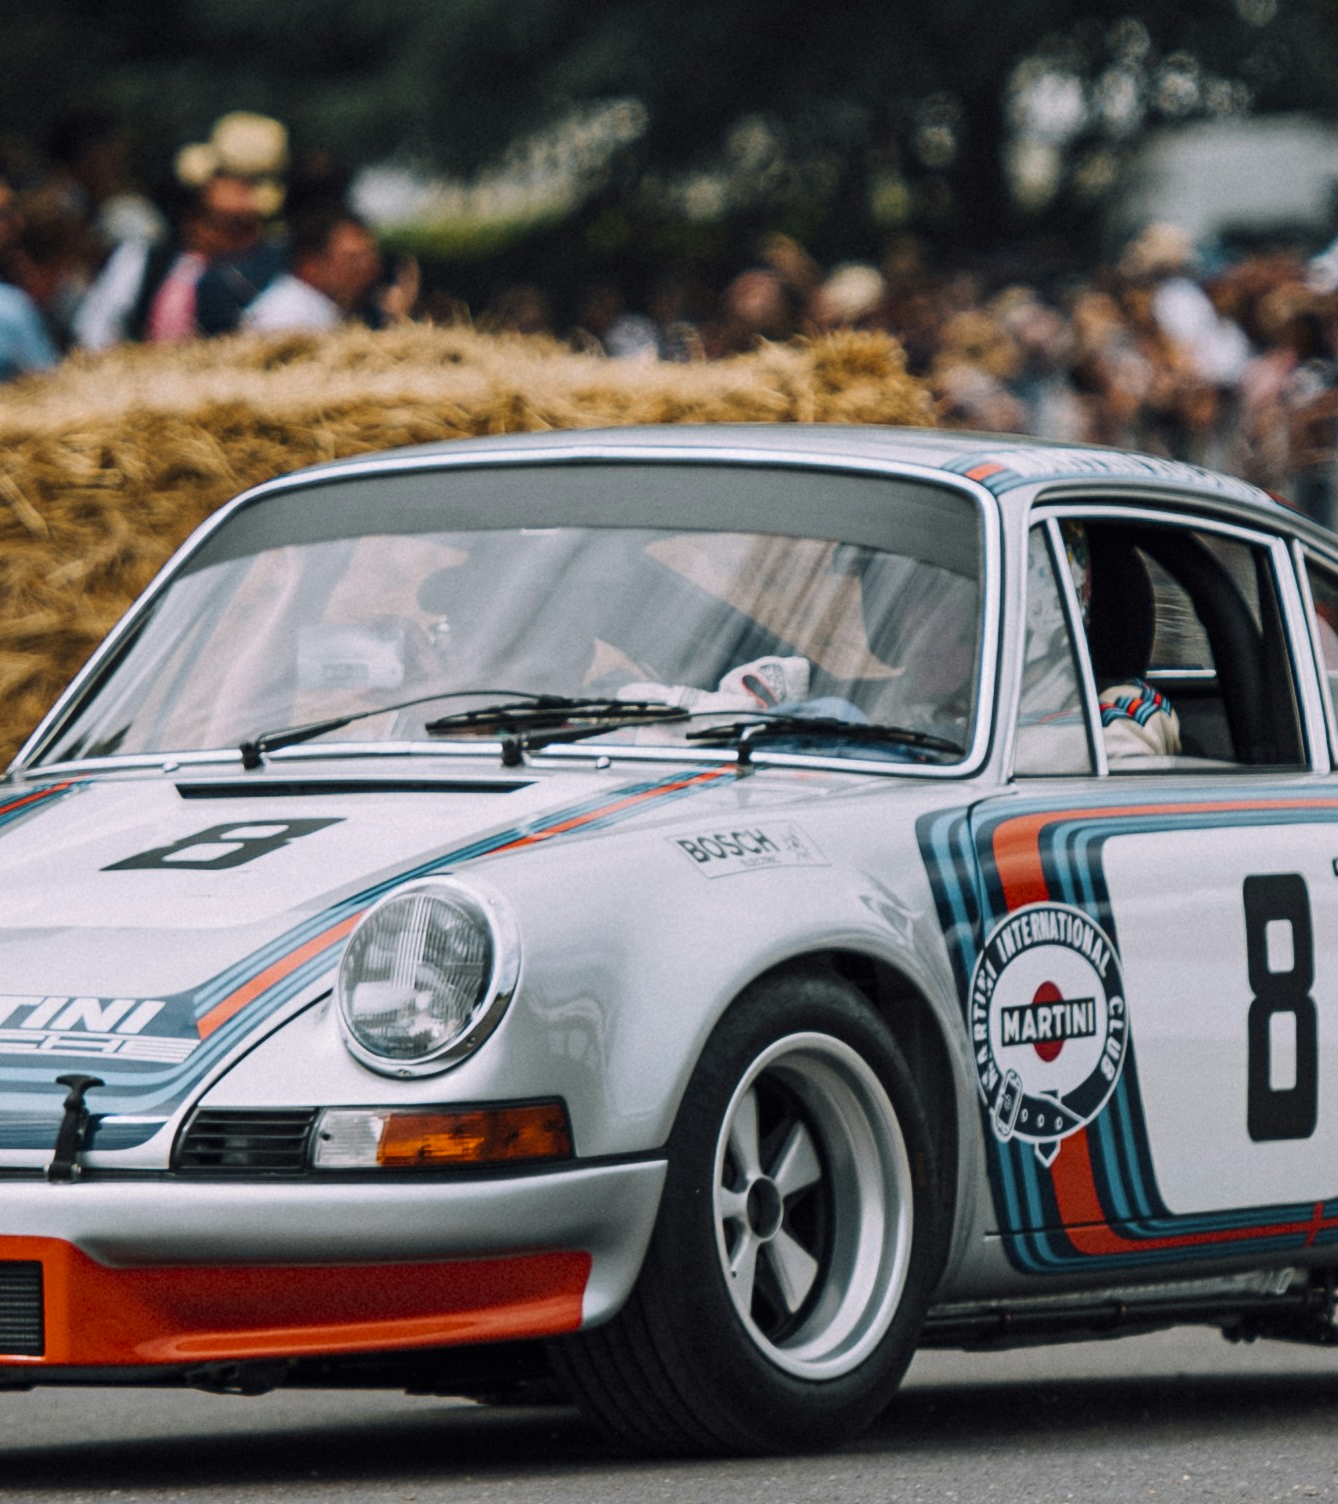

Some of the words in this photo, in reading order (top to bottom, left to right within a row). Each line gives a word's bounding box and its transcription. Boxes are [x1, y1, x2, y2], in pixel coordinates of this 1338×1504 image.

[98, 817, 349, 872] 8
[676, 828, 781, 863] BOSCH
[973, 958, 1000, 1091] MARTINI
[996, 910, 1112, 978] INTERNATIONAL
[1099, 995, 1125, 1082] CLUB
[1002, 1000, 1095, 1043] MARTINI
[1243, 872, 1318, 1143] 8
